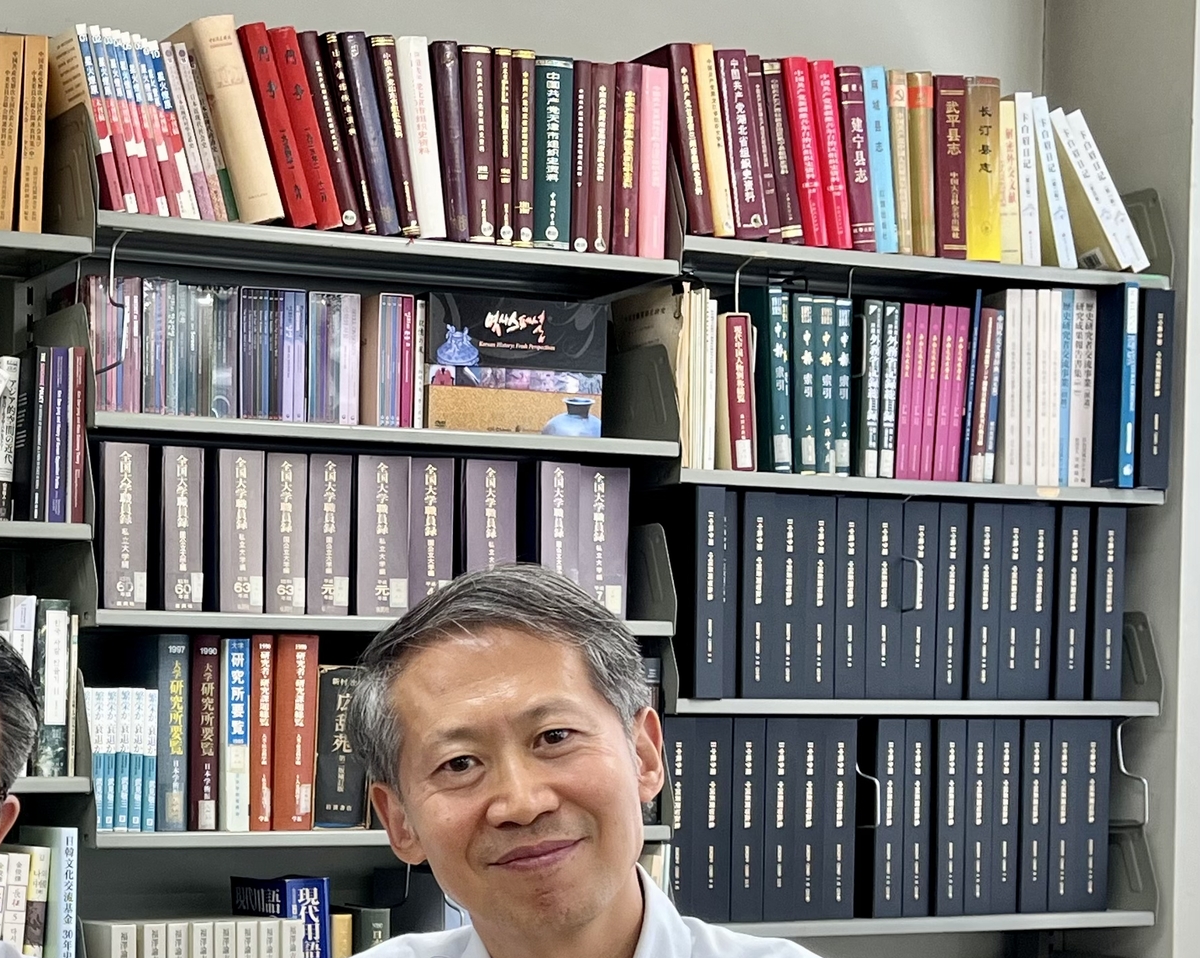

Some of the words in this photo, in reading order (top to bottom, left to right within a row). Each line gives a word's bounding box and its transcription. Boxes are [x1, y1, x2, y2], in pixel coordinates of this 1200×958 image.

[851, 117, 868, 184] 建宁县志
[945, 101, 962, 156] 武平县志
[978, 105, 993, 174] 长汀县志
[234, 582, 250, 593] 63
[277, 584, 294, 596] 63
[168, 645, 185, 654] 1997
[200, 647, 217, 655] 1990
[231, 652, 245, 735] 研究所要覧
[63, 836, 75, 925] 日韓文化交流基金
